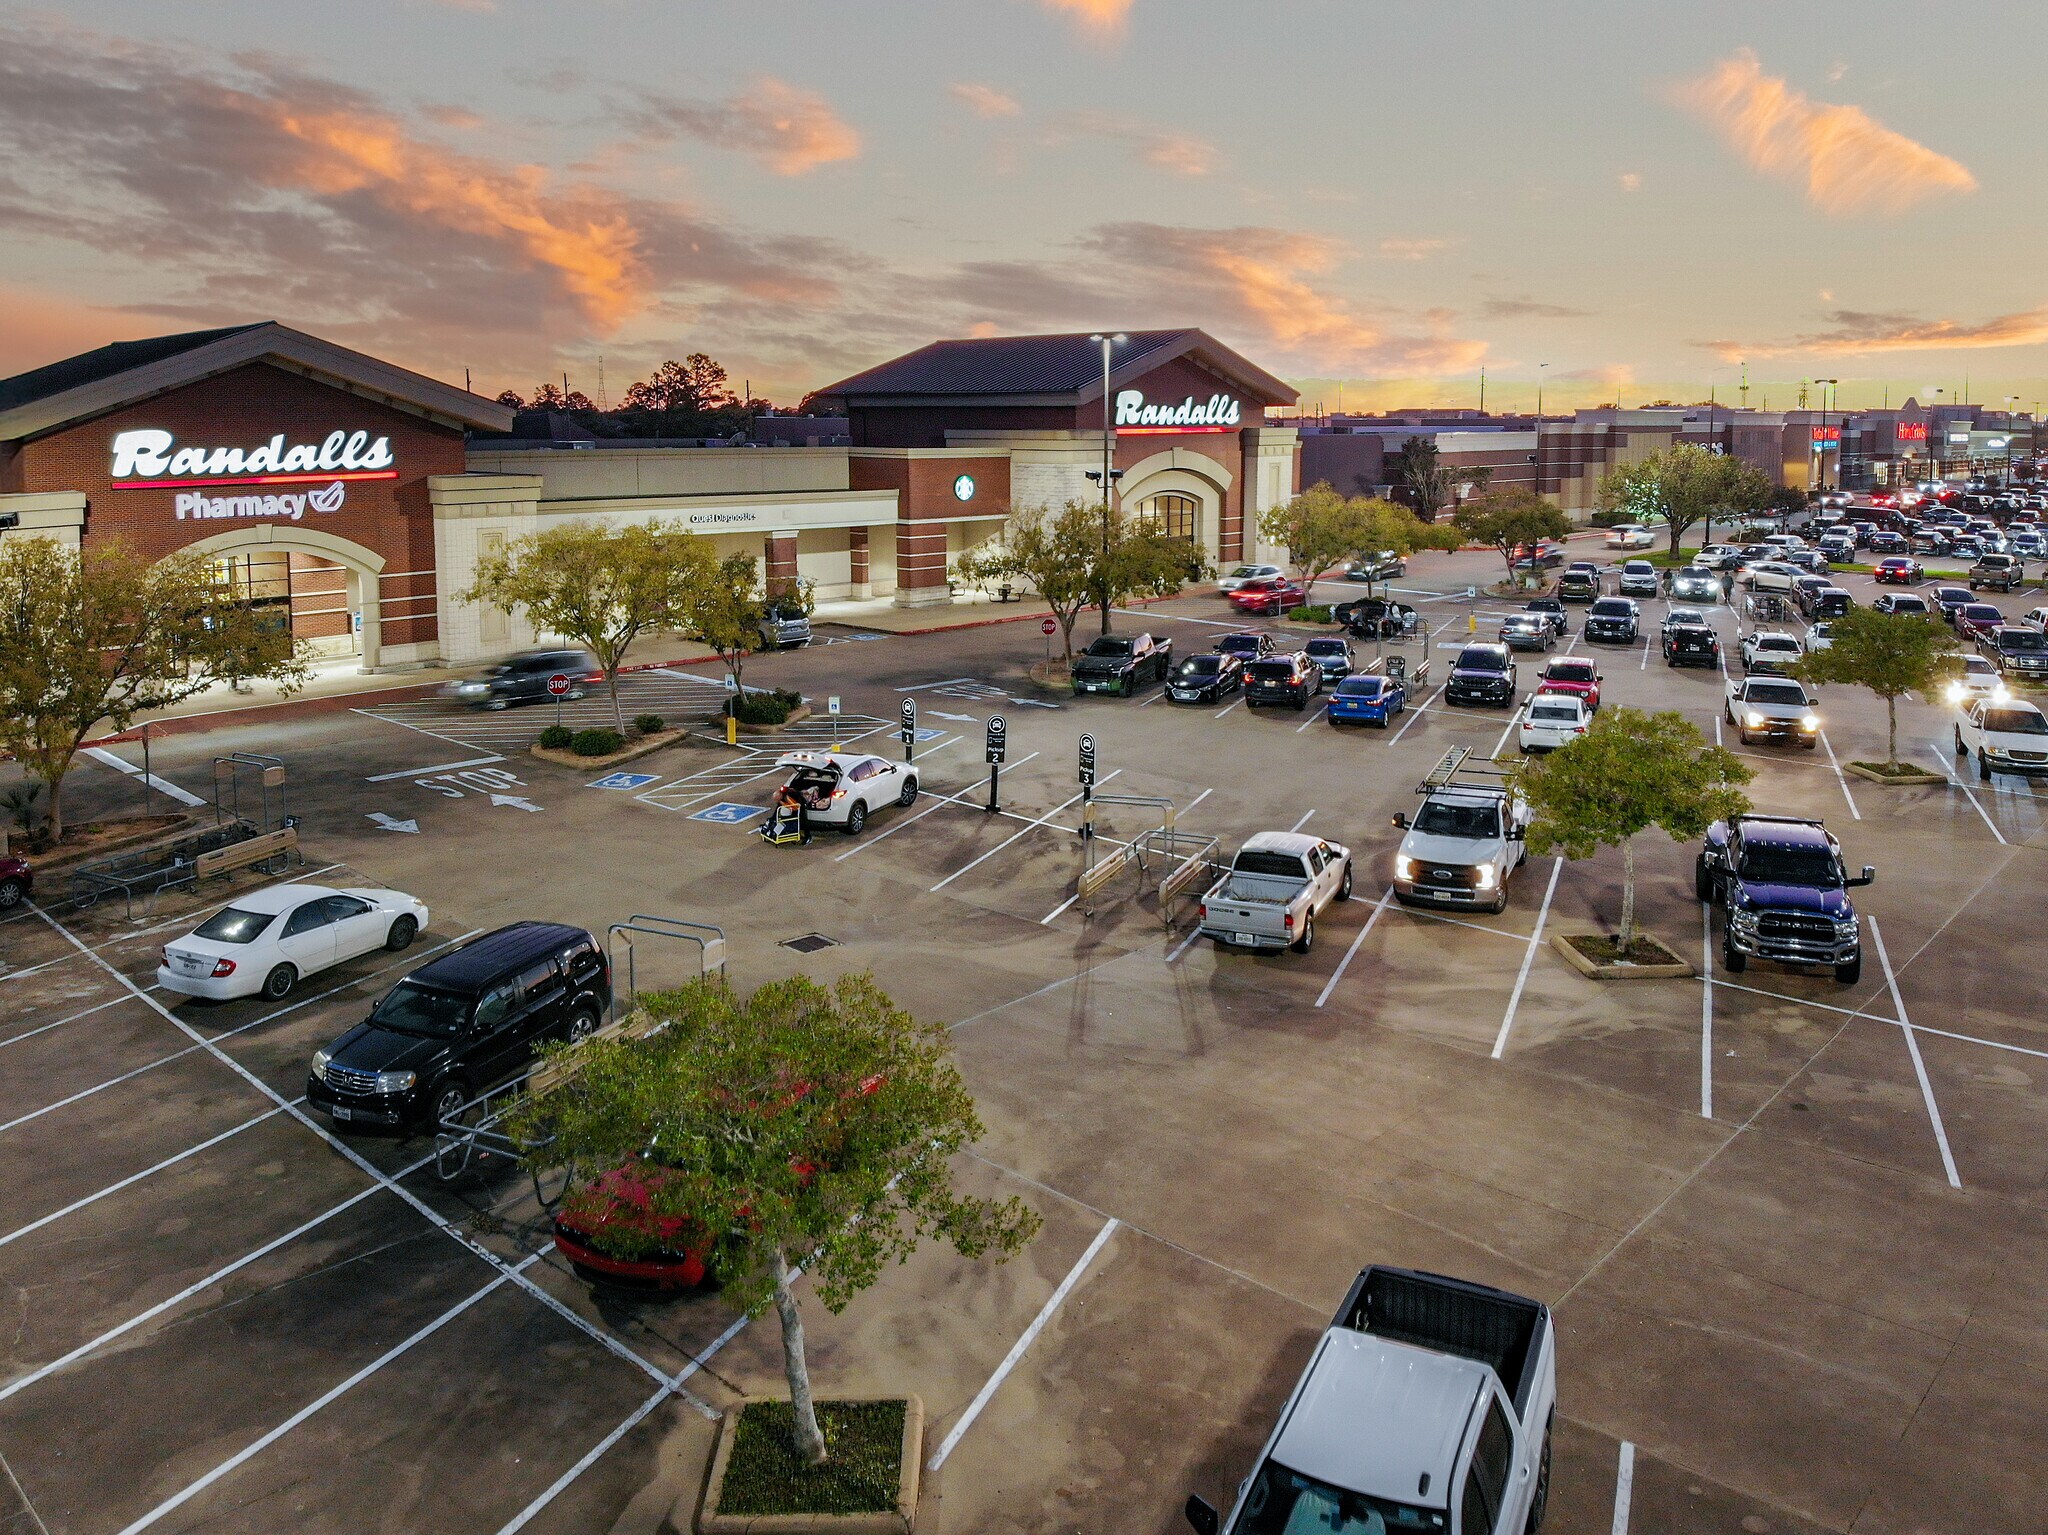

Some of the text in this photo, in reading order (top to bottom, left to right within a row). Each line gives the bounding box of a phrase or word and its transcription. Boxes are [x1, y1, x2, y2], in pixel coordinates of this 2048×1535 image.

[1116, 390, 1240, 425] Randalls
[112, 429, 395, 477] Randalls
[175, 491, 308, 520] Pharmacy
[1042, 623, 1056, 631] STOP
[549, 680, 568, 690] STOP
[905, 734, 910, 743] 1
[992, 753, 999, 763] 2
[414, 767, 529, 798] STOP
[1083, 773, 1090, 783] 3
